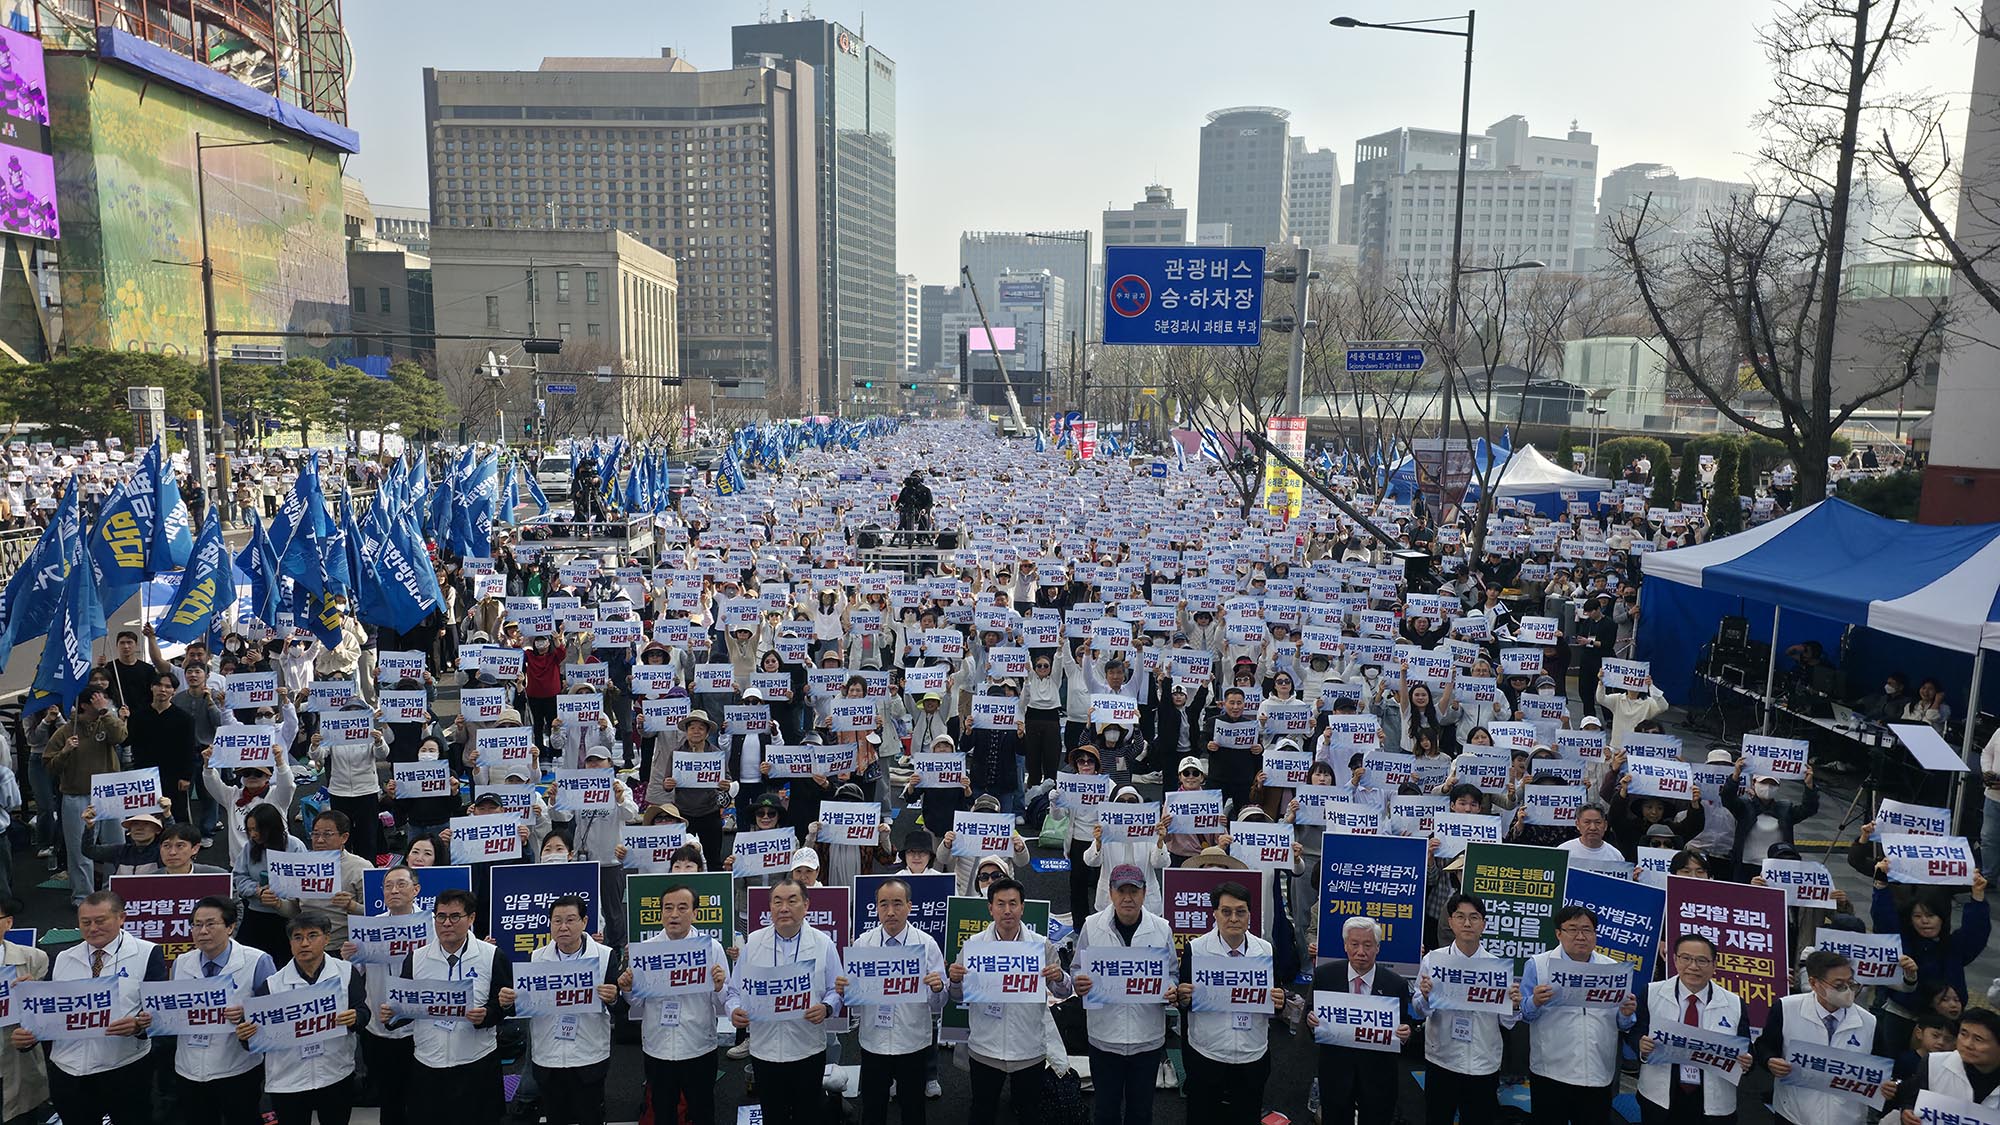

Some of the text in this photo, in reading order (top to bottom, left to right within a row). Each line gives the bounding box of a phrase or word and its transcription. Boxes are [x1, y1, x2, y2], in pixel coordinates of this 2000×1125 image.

[1165, 258, 1252, 281] 관광버스
[1159, 288, 1254, 309] 승·하차장
[1154, 319, 1257, 335] 5분경과시 과태료 부과
[1349, 352, 1402, 362] 세종대로21길
[102, 512, 144, 568] 반대
[172, 578, 216, 625] 반대
[519, 616, 552, 625] 차별금지법
[742, 613, 757, 621] 반대
[535, 624, 552, 632] 반대
[1094, 628, 1131, 637] 차별금지법
[1520, 623, 1556, 631] 차별금지법
[1536, 630, 1554, 640] 반대
[1111, 636, 1130, 646] 반대
[1409, 657, 1450, 668] 차별금지법
[1604, 664, 1646, 676] 차별금지법
[634, 671, 673, 681] 차별금지법
[906, 672, 943, 681] 차별금지법
[1428, 667, 1449, 678] 반대
[227, 680, 273, 692] 차별금지법
[653, 680, 672, 690] 반대
[924, 679, 943, 689] 반대
[1623, 675, 1645, 687] 반대
[249, 691, 273, 702] 반대
[558, 701, 600, 713] 차별금지법
[973, 704, 1015, 714] 차별금지법
[578, 711, 599, 721] 반대
[993, 714, 1016, 725] 반대
[1332, 722, 1376, 733] 차별금지법
[214, 734, 271, 747] 차별금지법
[478, 736, 527, 748] 차별금지법
[1353, 733, 1375, 744] 반대
[240, 747, 268, 761] 반대
[502, 747, 527, 759] 반대
[1746, 745, 1804, 760] 차별금지법
[1459, 765, 1506, 777] 차별금지법
[1632, 764, 1688, 778] 차별금지법
[1771, 759, 1800, 774] 반대
[94, 778, 155, 798] 차별금지법
[1481, 775, 1504, 787] 반대
[1659, 778, 1687, 792] 반대
[123, 793, 155, 810] 반대
[822, 812, 875, 826] 차별금지법
[453, 823, 516, 841] 차별금지법
[847, 826, 874, 839] 반대
[956, 822, 1010, 837] 차별금지법
[484, 837, 516, 854] 반대
[981, 837, 1009, 851] 반대
[1234, 833, 1289, 847] 차별금지법
[1260, 847, 1288, 862] 반대
[1888, 844, 1966, 860] 차별금지법
[270, 862, 335, 877] 차별금지법
[1331, 862, 1418, 880] 이름은 차별금지,
[1476, 864, 1555, 881] 특권 없는 평등이
[1765, 868, 1830, 886] 차별금지법
[1928, 861, 1967, 877] 반대
[301, 878, 334, 892] 반대
[1328, 880, 1416, 896] 실체는 반대금지!
[1475, 879, 1553, 897] 진짜 평등이다
[1797, 885, 1829, 901] 반대
[125, 900, 175, 916] 생각할
[504, 894, 531, 911] 입을
[921, 902, 947, 917] 법은
[1330, 899, 1413, 919] 가짜 평등법
[1513, 901, 1552, 917] 국민의
[1174, 911, 1208, 929] 말할
[1598, 905, 1653, 931] 차별금지,
[1680, 902, 1771, 930] 생각할 권리,
[123, 919, 165, 938] 말할
[352, 923, 427, 942] 차별금지법
[1482, 914, 1541, 938] 권익을
[1726, 929, 1773, 953] 자유!
[632, 949, 706, 971] 차별금지법
[847, 959, 920, 977] 차별금지법
[968, 956, 1039, 973] 차별금지법
[670, 966, 706, 987] 반대
[1091, 960, 1163, 977] 차별금지법
[1431, 965, 1507, 988] 차별금지법
[1857, 961, 1896, 978] 반대
[517, 971, 594, 992] 차별금지법
[742, 972, 811, 997] 차별금지법
[883, 976, 919, 995] 반대
[1002, 975, 1038, 994] 반대
[1126, 977, 1162, 995] 반대
[1196, 970, 1268, 986] 차별금지법
[1551, 970, 1627, 988] 차별금지법
[23, 990, 112, 1014] 차별금지법
[145, 989, 226, 1011] 차별금지법
[390, 988, 467, 1004] 차별금지법
[555, 989, 593, 1007] 반대
[774, 991, 810, 1013] 반대
[1231, 987, 1266, 1005] 반대
[1467, 986, 1505, 1005] 반대
[1585, 988, 1626, 1003] 반대
[188, 1007, 226, 1026] 반대
[249, 995, 337, 1026] 차별금지법
[428, 1004, 467, 1018] 반대
[1318, 1005, 1393, 1028] 차별금지법
[66, 1008, 111, 1031] 반대
[294, 1013, 337, 1038] 반대
[561, 1025, 574, 1033] VIP
[1354, 1026, 1391, 1046] 반대
[1653, 1029, 1740, 1060] 차별금지법
[1690, 1050, 1736, 1073] 반대
[1791, 1051, 1883, 1084] 차별금지법
[1684, 1067, 1698, 1076] VIP
[1829, 1076, 1878, 1099] 반대
